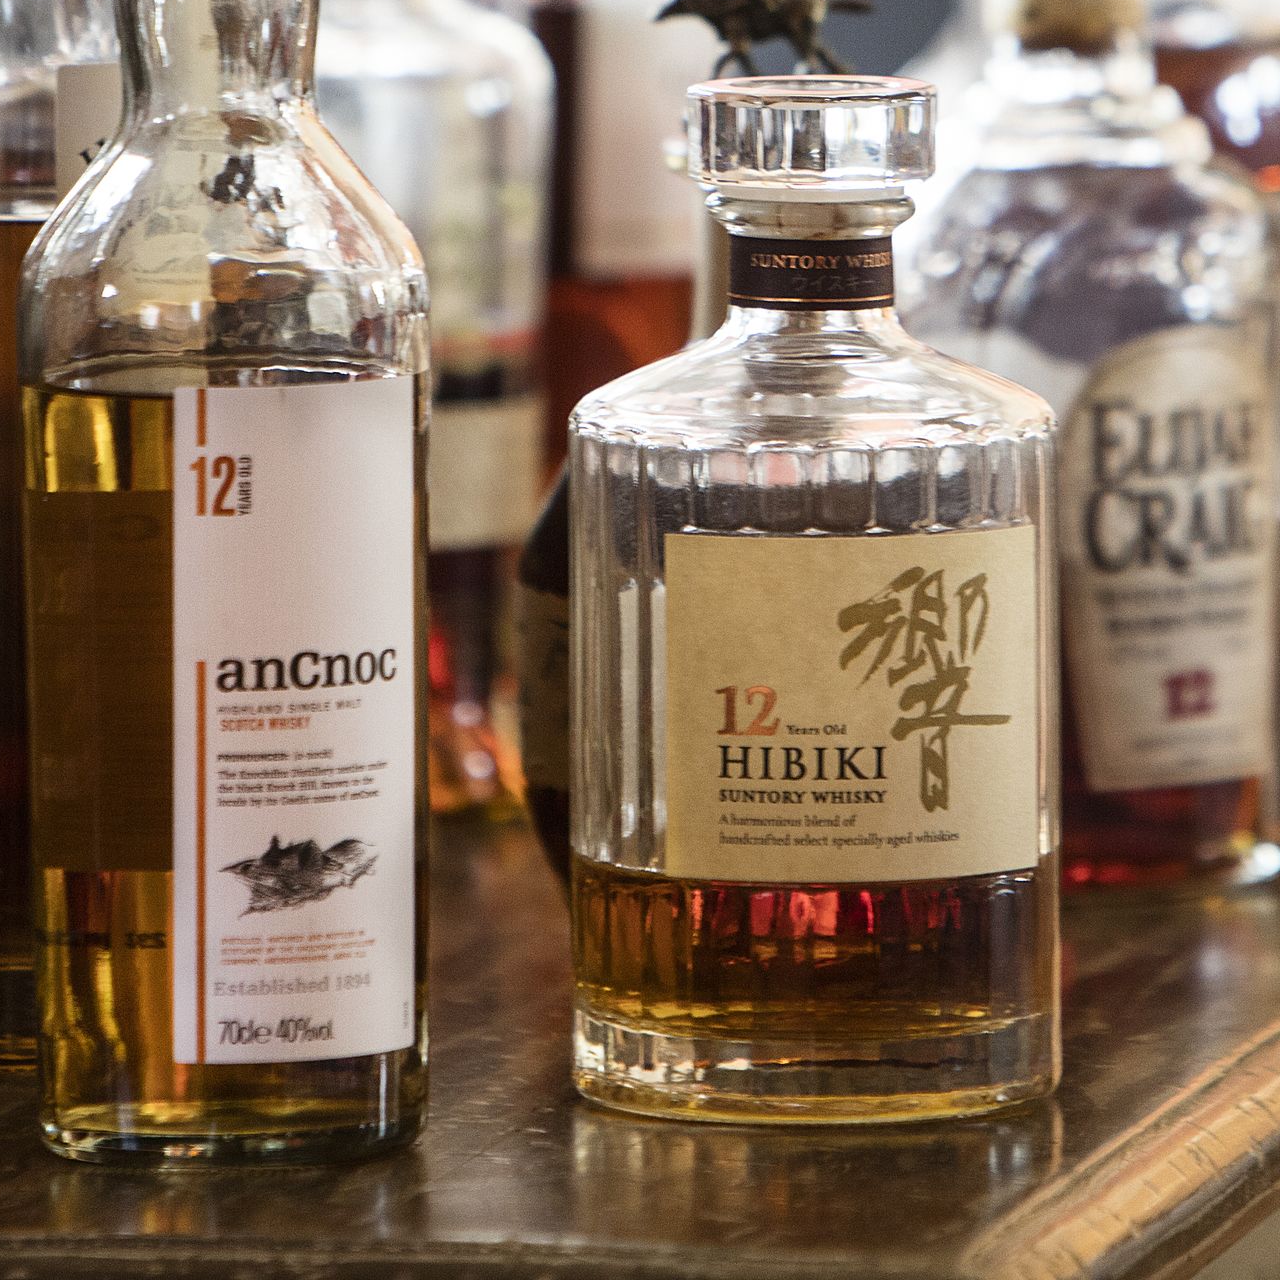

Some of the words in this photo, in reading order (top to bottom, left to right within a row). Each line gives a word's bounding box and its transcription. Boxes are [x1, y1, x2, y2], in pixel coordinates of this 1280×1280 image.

[750, 253, 842, 269] SUNTORY
[237, 456, 252, 478] OLD
[190, 455, 237, 517] 12
[216, 648, 398, 693] anCnoc
[287, 701, 330, 714] SINGLE
[715, 685, 781, 736] 12
[786, 724, 820, 736] Years
[823, 724, 847, 736] Old
[220, 719, 266, 732] SCOTCH
[268, 717, 311, 730] WHISKY
[718, 745, 888, 780] HIBIKI
[719, 789, 807, 805] SUNTORY
[811, 789, 888, 805] WHISKY
[842, 813, 858, 827] of
[794, 832, 828, 846] select
[214, 976, 330, 997] Established
